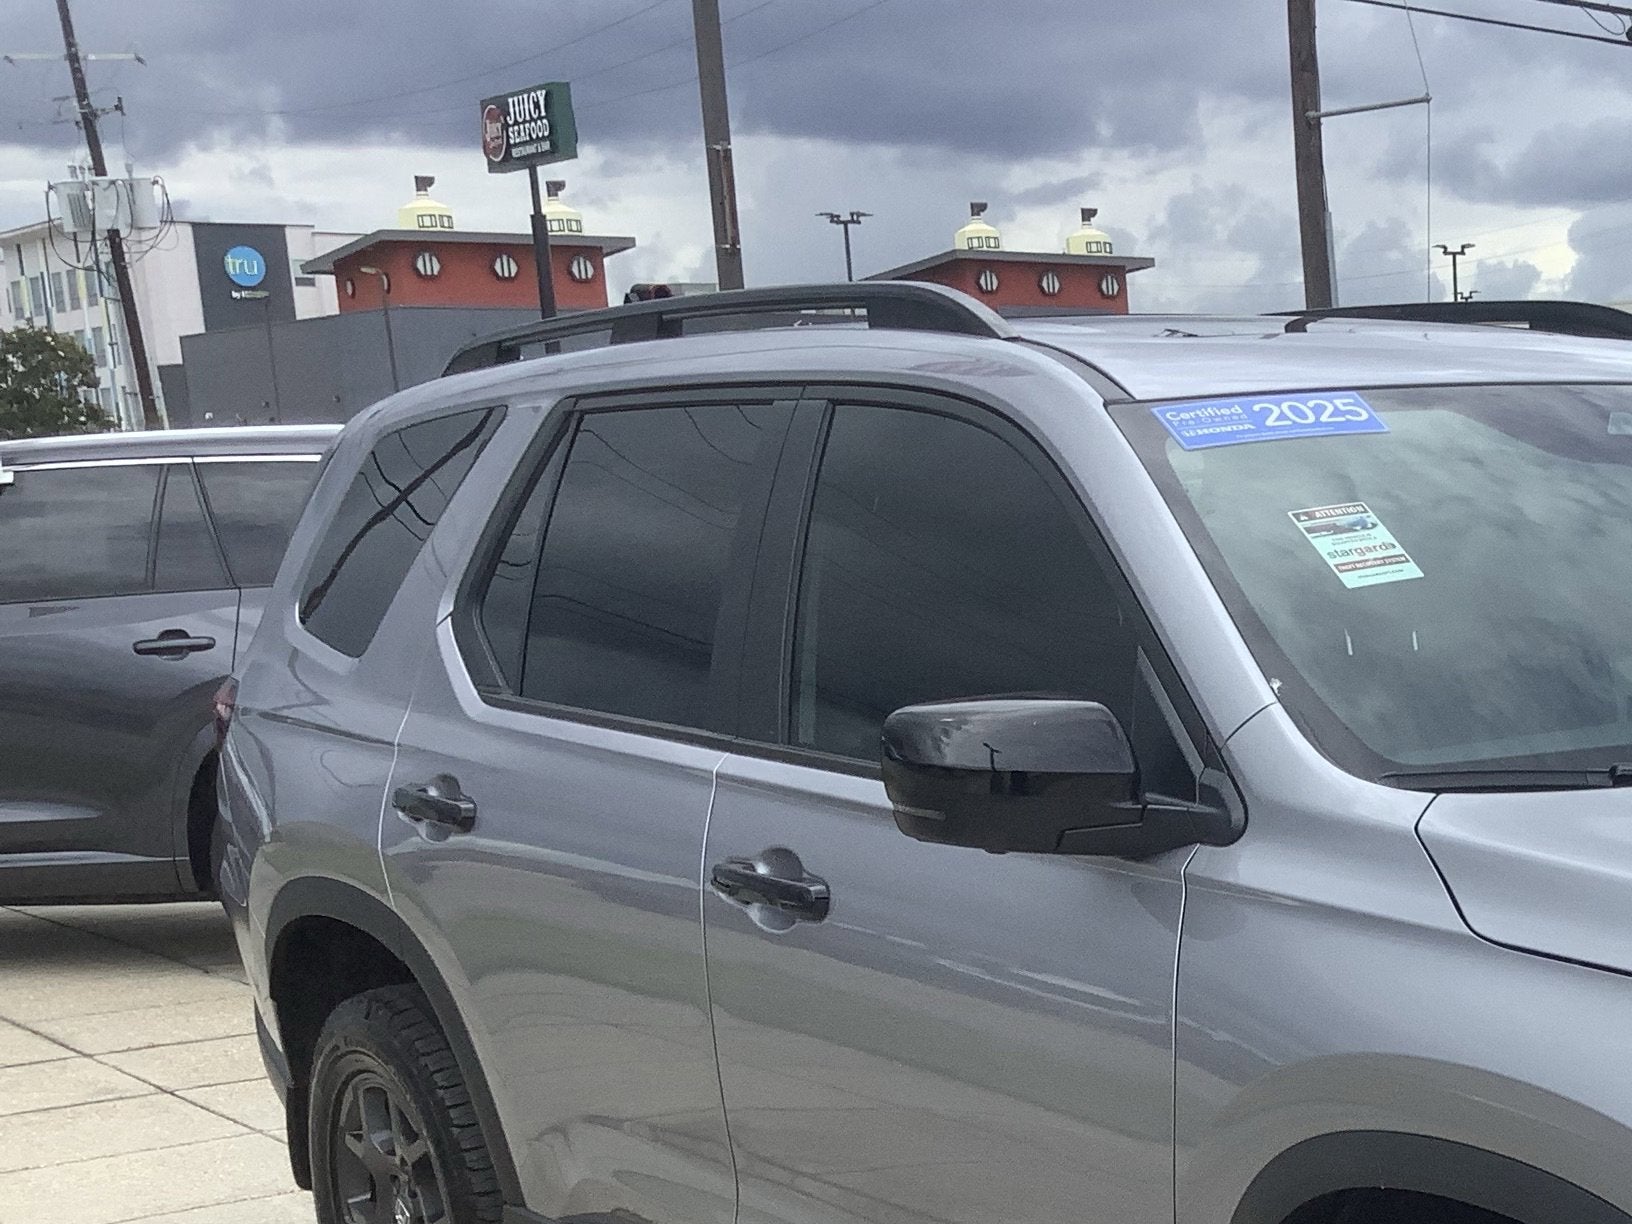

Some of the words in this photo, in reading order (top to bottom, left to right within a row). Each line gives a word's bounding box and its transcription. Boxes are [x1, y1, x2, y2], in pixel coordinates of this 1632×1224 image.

[506, 89, 546, 125] JUICY
[508, 119, 550, 145] SEAFOOD
[224, 254, 258, 275] tru
[1166, 404, 1244, 420] Certified
[1252, 399, 1370, 427] 2025
[1194, 423, 1257, 436] HONDA
[1315, 505, 1365, 518] ATTENTION
